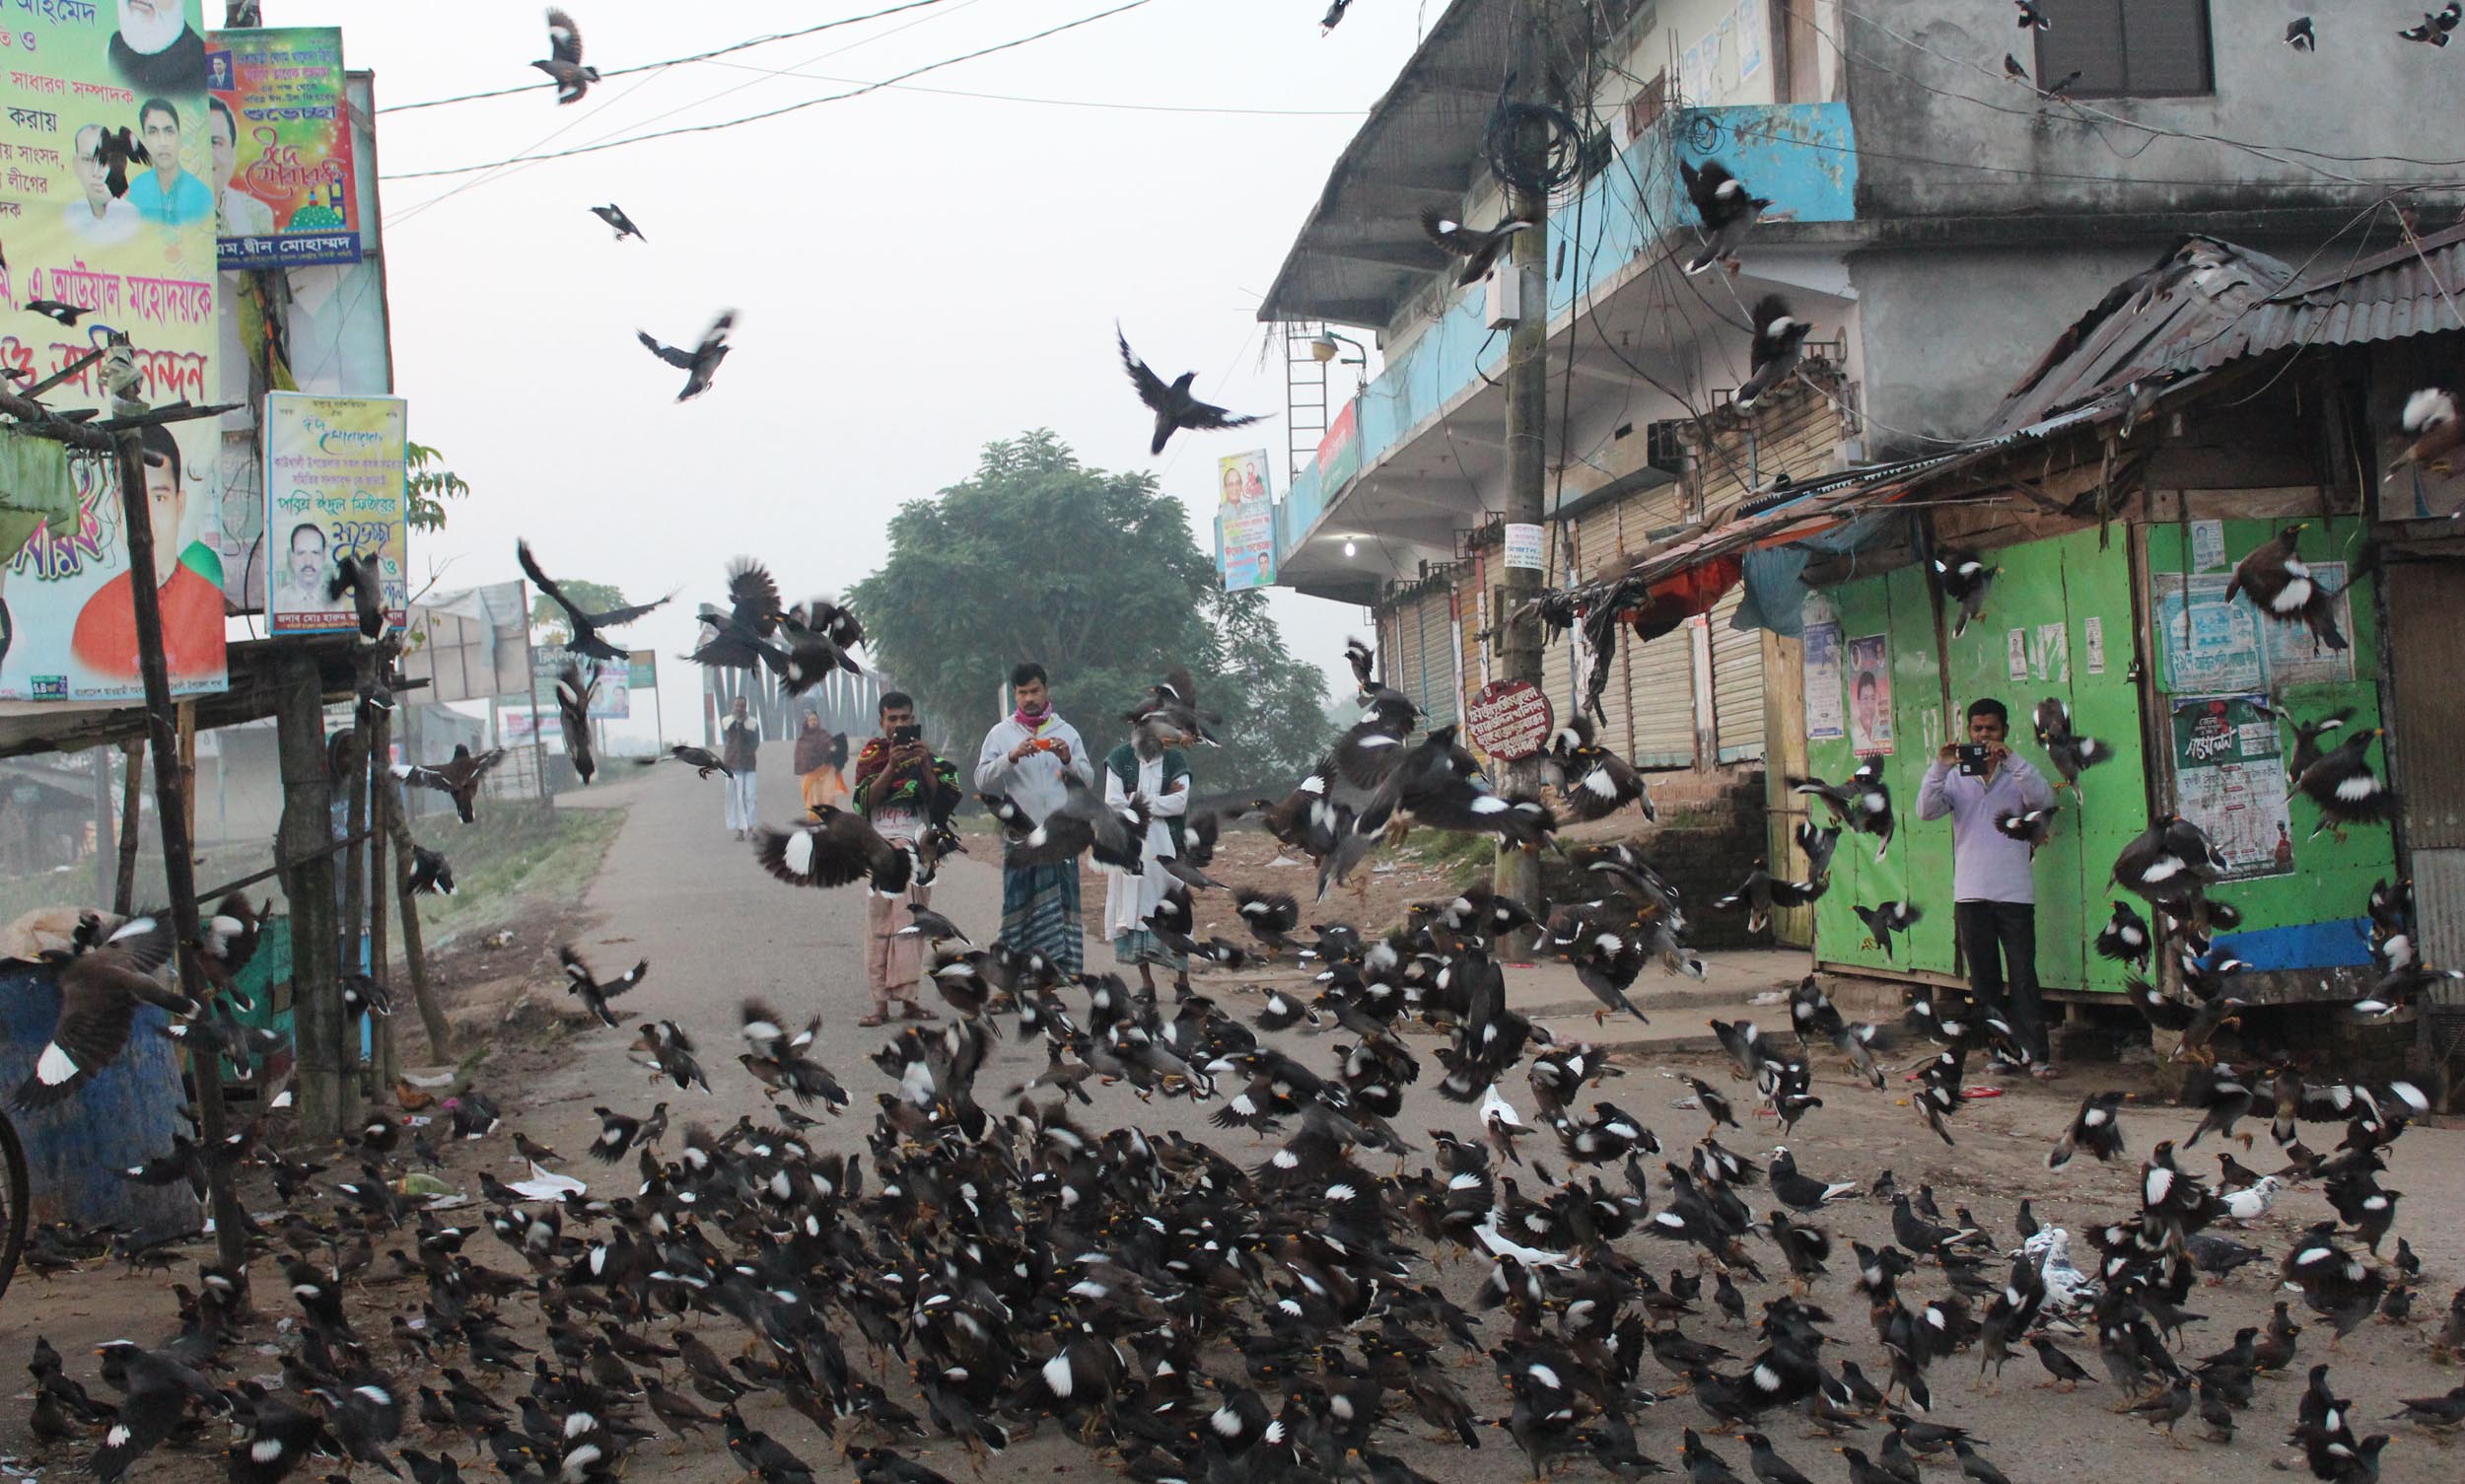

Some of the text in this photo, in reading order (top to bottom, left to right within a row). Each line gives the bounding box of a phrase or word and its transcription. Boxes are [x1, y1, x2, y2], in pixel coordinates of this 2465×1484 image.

[10, 71, 133, 104] সাধারণ সম্পাদক
[8, 168, 47, 194] লীগের
[280, 237, 350, 251] মোহাম্মদ
[126, 274, 211, 327] মহোদয়কে
